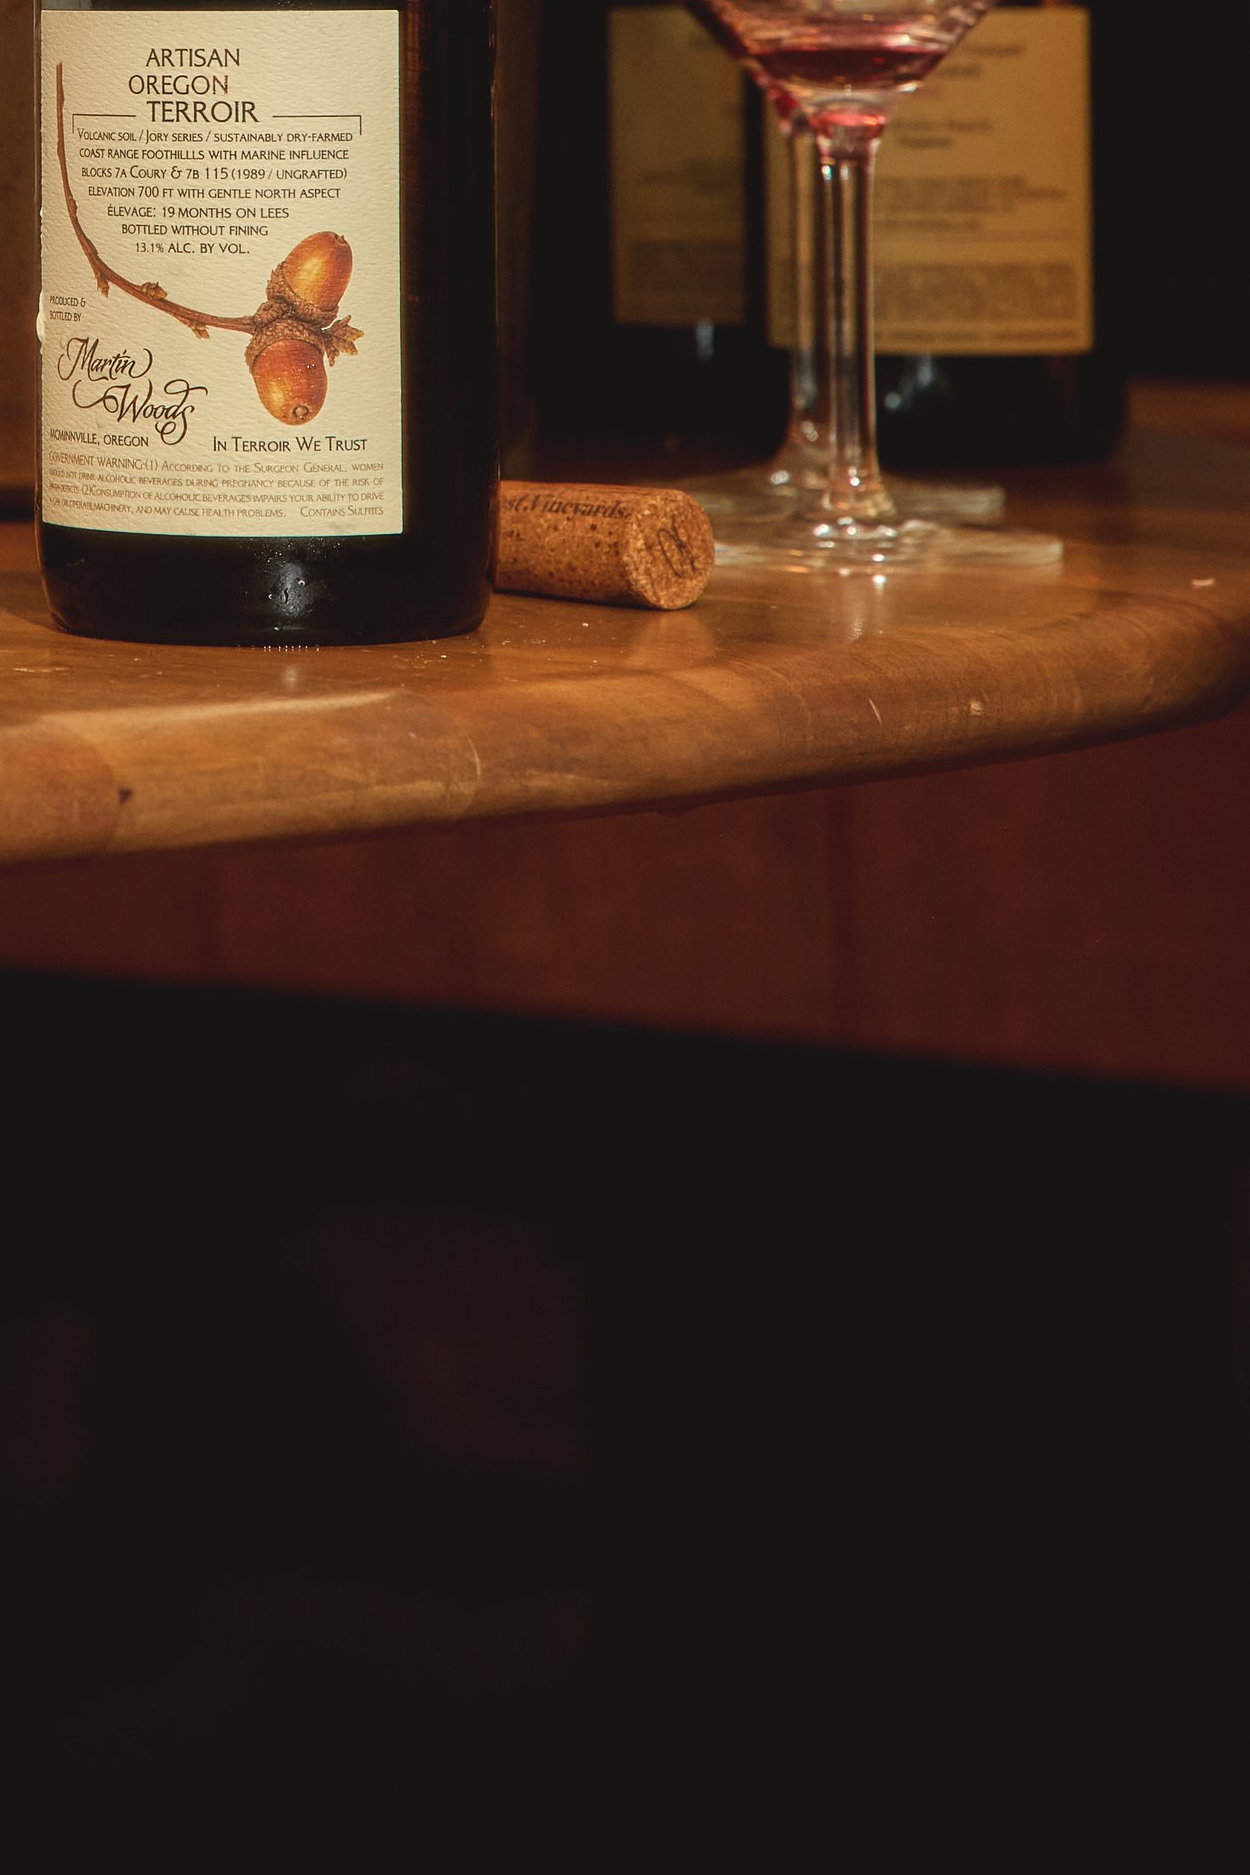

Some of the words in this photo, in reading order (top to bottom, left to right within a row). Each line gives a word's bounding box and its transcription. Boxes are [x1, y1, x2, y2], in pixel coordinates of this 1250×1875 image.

[146, 48, 240, 67] ARTISAN
[128, 74, 229, 95] OREGON
[146, 101, 260, 123] TERROIR
[118, 131, 136, 142] SOIL
[171, 132, 203, 142] SERIES
[214, 133, 283, 143] SUSTAINABLY
[287, 132, 353, 142] DRY-FARMED
[79, 148, 106, 158] COAST
[108, 149, 139, 159] RANGE
[209, 150, 237, 160] WITH
[240, 150, 286, 160] MARINE
[289, 150, 350, 160] INFLUENCE
[81, 167, 112, 178] BLOCKS
[170, 166, 183, 179] &
[205, 167, 229, 180] 115
[231, 168, 266, 180] (1989
[276, 168, 348, 180] UNGRAFTED)
[88, 186, 135, 197] ELEVATION
[138, 186, 160, 198] 700
[162, 188, 174, 198] FT
[177, 188, 205, 199] WITH
[208, 188, 251, 199] GENTLE
[255, 188, 296, 199] NORTH
[299, 188, 341, 199] ASPECT
[107, 204, 157, 218] ÉLEVAGE:
[162, 206, 175, 218] 19
[178, 207, 232, 219] MONTHS
[235, 207, 256, 219] ON
[260, 207, 290, 219] LEES
[121, 224, 168, 235] BOTTLED
[171, 225, 225, 236] WITHOUT
[229, 225, 269, 236] FINING
[136, 242, 165, 253] 13.1%
[168, 243, 195, 254] ALC.
[200, 243, 215, 254] BY
[219, 243, 250, 254] VOL.
[50, 295, 79, 307] PRODUCED
[80, 297, 86, 308] &
[50, 310, 73, 322] BOTTLED
[73, 312, 82, 322] BY
[58, 337, 153, 382] Martin
[72, 379, 208, 446] Woods
[103, 434, 149, 447] OREGON
[49, 451, 94, 466] GOVERNMENT
[217, 464, 230, 473] TO
[234, 464, 250, 473] THE
[351, 463, 384, 471] WOMEN
[97, 474, 137, 484] ALCOHOLIC
[138, 476, 183, 487] BEVERAGES
[185, 478, 219, 488] DURING
[221, 479, 274, 488] PREGNANCY
[277, 479, 315, 488] BECAUSE
[318, 479, 331, 487] OF
[334, 478, 349, 487] THE
[352, 477, 370, 486] RISK
[373, 477, 384, 486] OF
[142, 492, 153, 500] OF
[154, 492, 202, 502] ALCOHOLIC
[203, 494, 251, 503] BEVERAGES
[253, 494, 287, 503] IMPAIRS
[289, 494, 314, 503] YOUR
[315, 493, 346, 502] ABILITY
[348, 493, 359, 502] TO
[361, 492, 384, 501] DRIVE
[93, 503, 134, 515] MACHINERY,
[136, 506, 153, 515] AND
[154, 507, 172, 516] MAY
[173, 508, 200, 517] CAUSE
[201, 508, 235, 518] HEALTH
